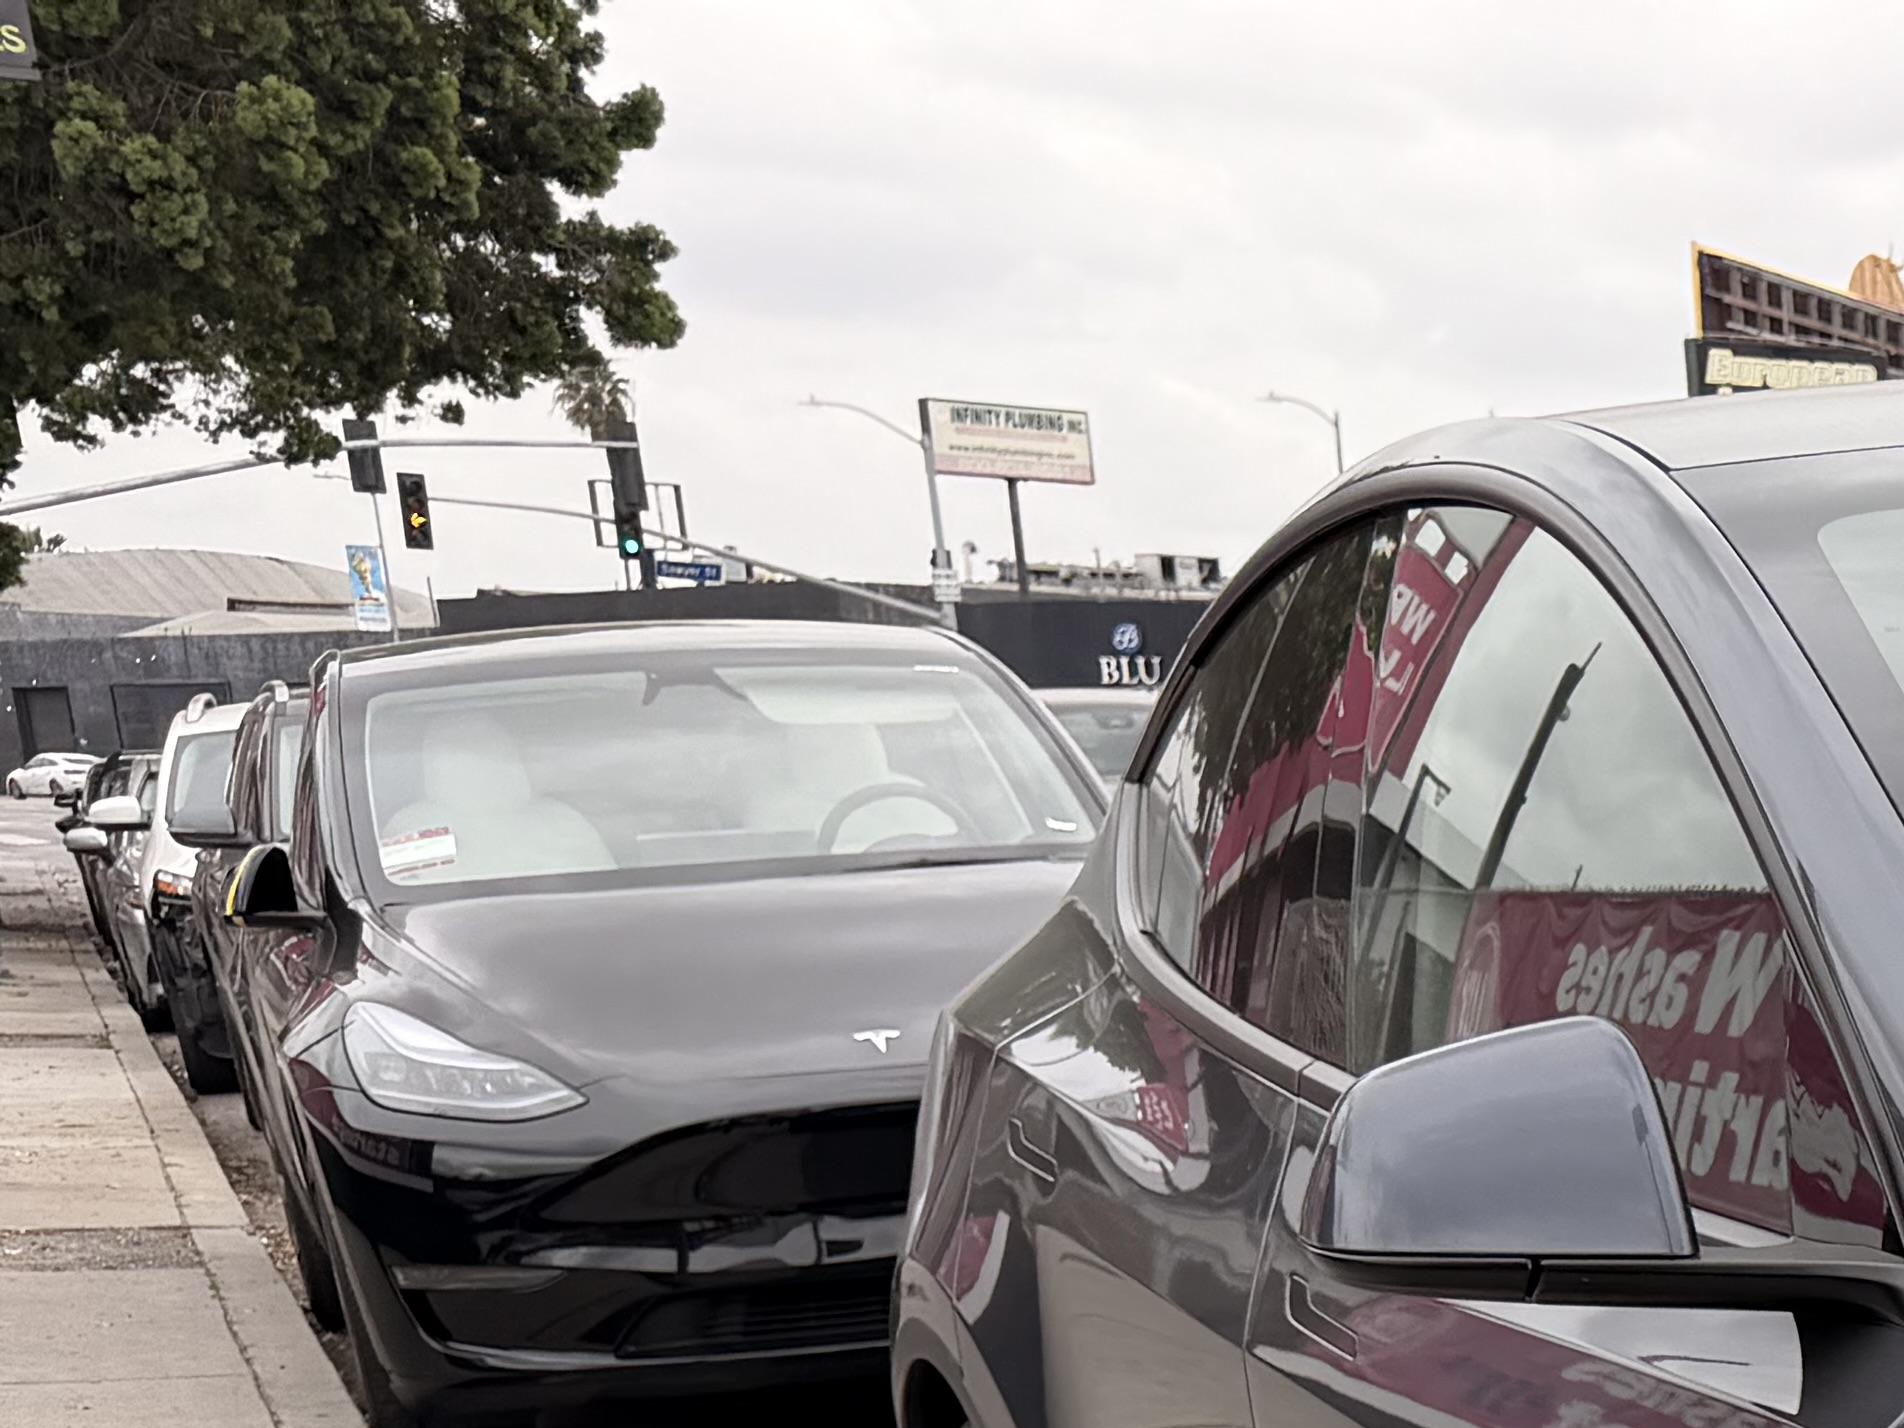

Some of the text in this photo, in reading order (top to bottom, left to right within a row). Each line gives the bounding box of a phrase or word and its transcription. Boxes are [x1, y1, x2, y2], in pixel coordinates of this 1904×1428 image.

[951, 406, 1001, 427] INFINITY
[1004, 409, 1065, 432] PLUMBING
[1098, 655, 1162, 685] BLU
